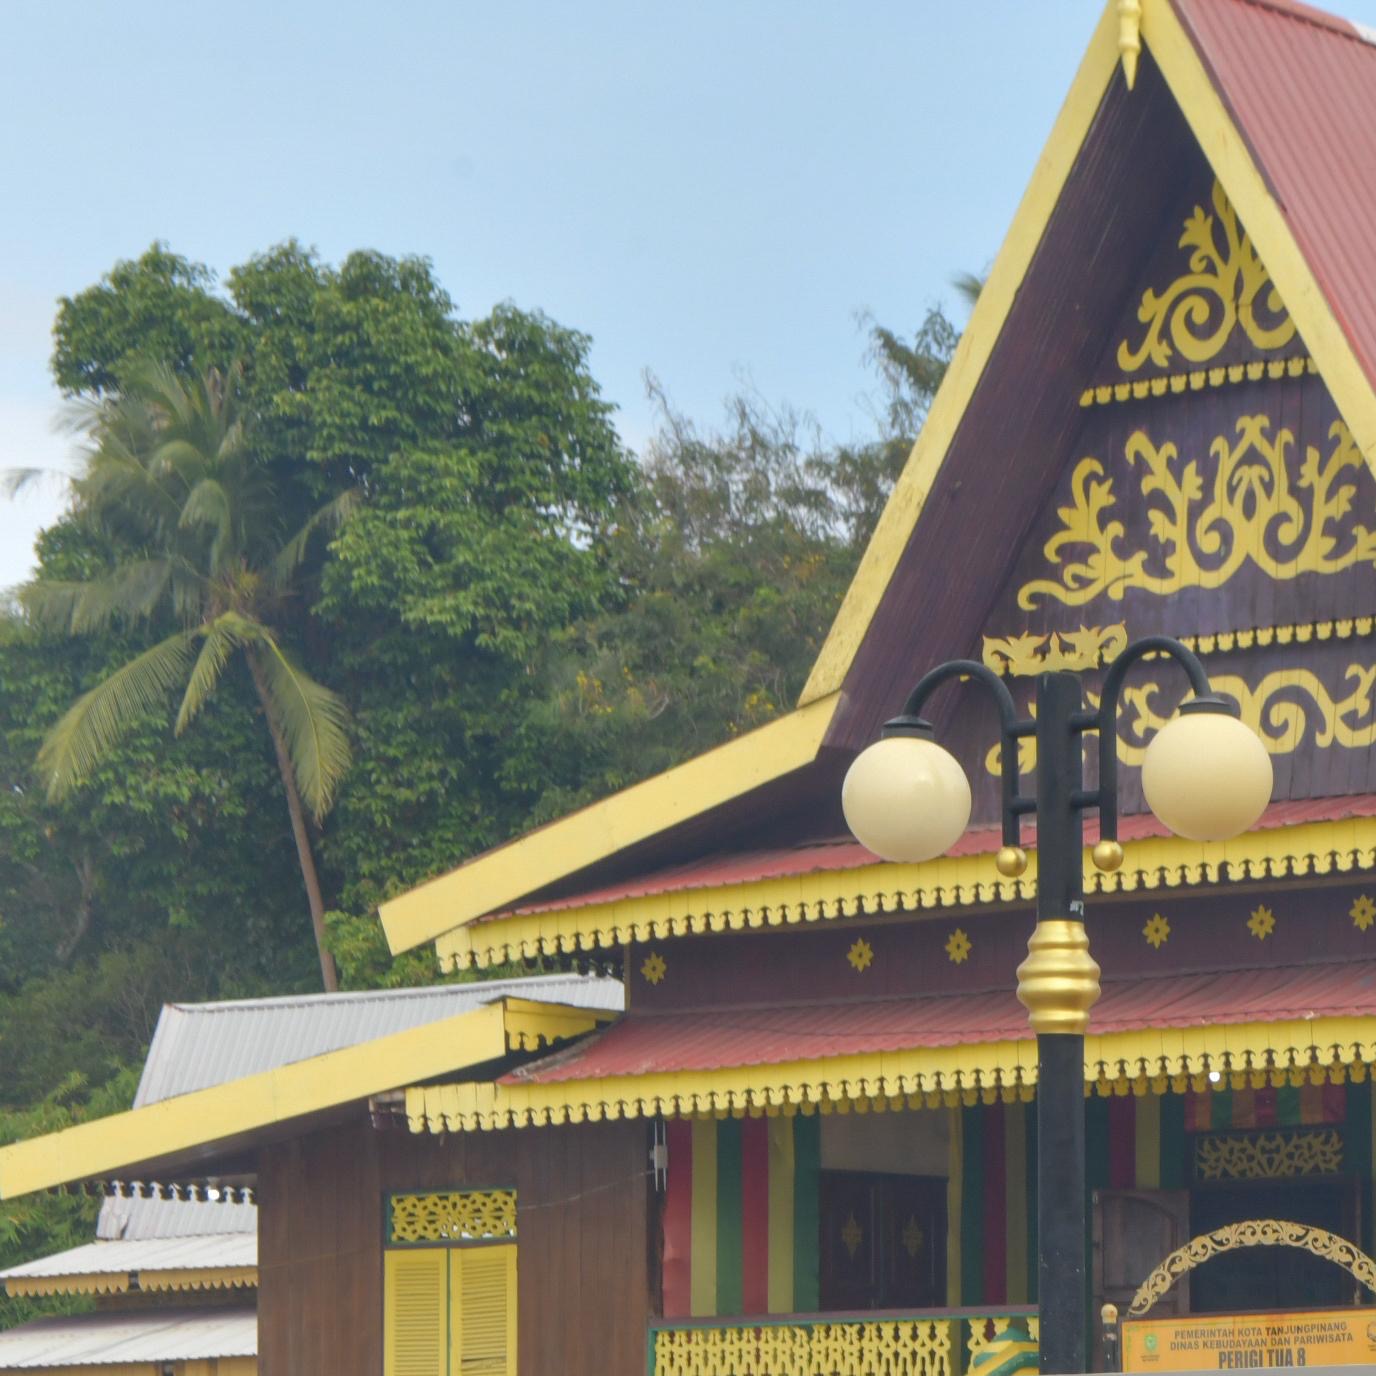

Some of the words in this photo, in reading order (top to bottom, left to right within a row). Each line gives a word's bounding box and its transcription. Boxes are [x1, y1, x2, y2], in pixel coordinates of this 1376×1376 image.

[1174, 1327, 1234, 1340] PEMERINTAH
[1237, 1327, 1263, 1337] KOTA
[1265, 1321, 1347, 1337] TANJUNGPINANG
[1170, 1341, 1200, 1351] DINAS
[1202, 1337, 1267, 1349] KEBUDAYAAN
[1271, 1336, 1291, 1347] DAN
[1294, 1332, 1354, 1345] PARIWISATA
[1218, 1349, 1264, 1369] PERIGI
[1266, 1348, 1293, 1367] TUA
